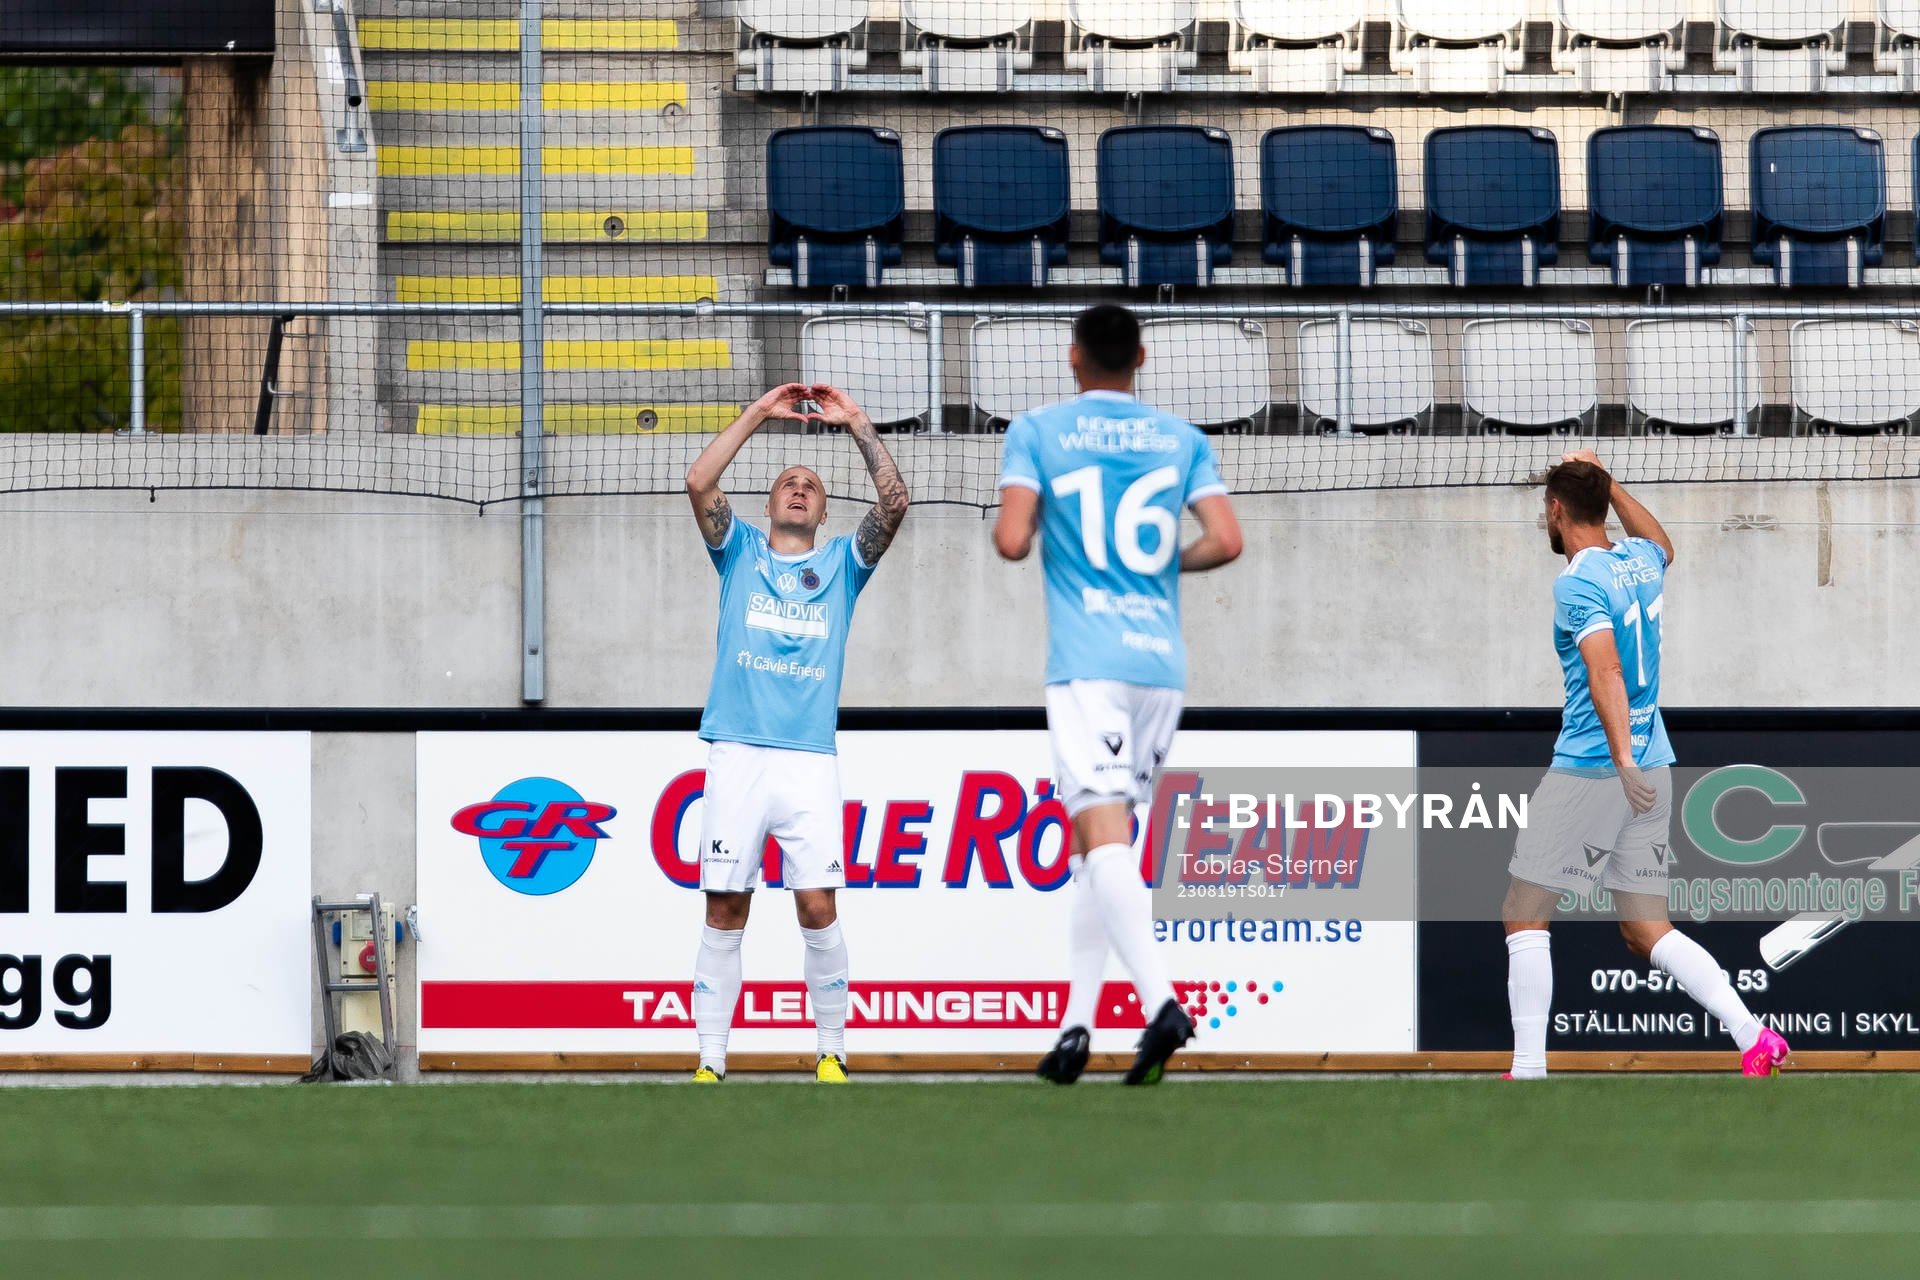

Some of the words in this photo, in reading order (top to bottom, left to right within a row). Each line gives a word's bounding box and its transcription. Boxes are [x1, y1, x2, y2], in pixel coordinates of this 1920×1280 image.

[1058, 431, 1181, 452] WELLNESS
[1051, 465, 1181, 576] 16
[750, 595, 825, 621] SANDVIK
[1624, 593, 1663, 687] 11
[754, 656, 788, 674] Gävle
[789, 662, 825, 680] Energi
[1591, 969, 1684, 991] 070-57
[1737, 969, 1768, 990] 53
[623, 991, 697, 1021] TA
[1554, 1011, 1694, 1033] STÄLLNING
